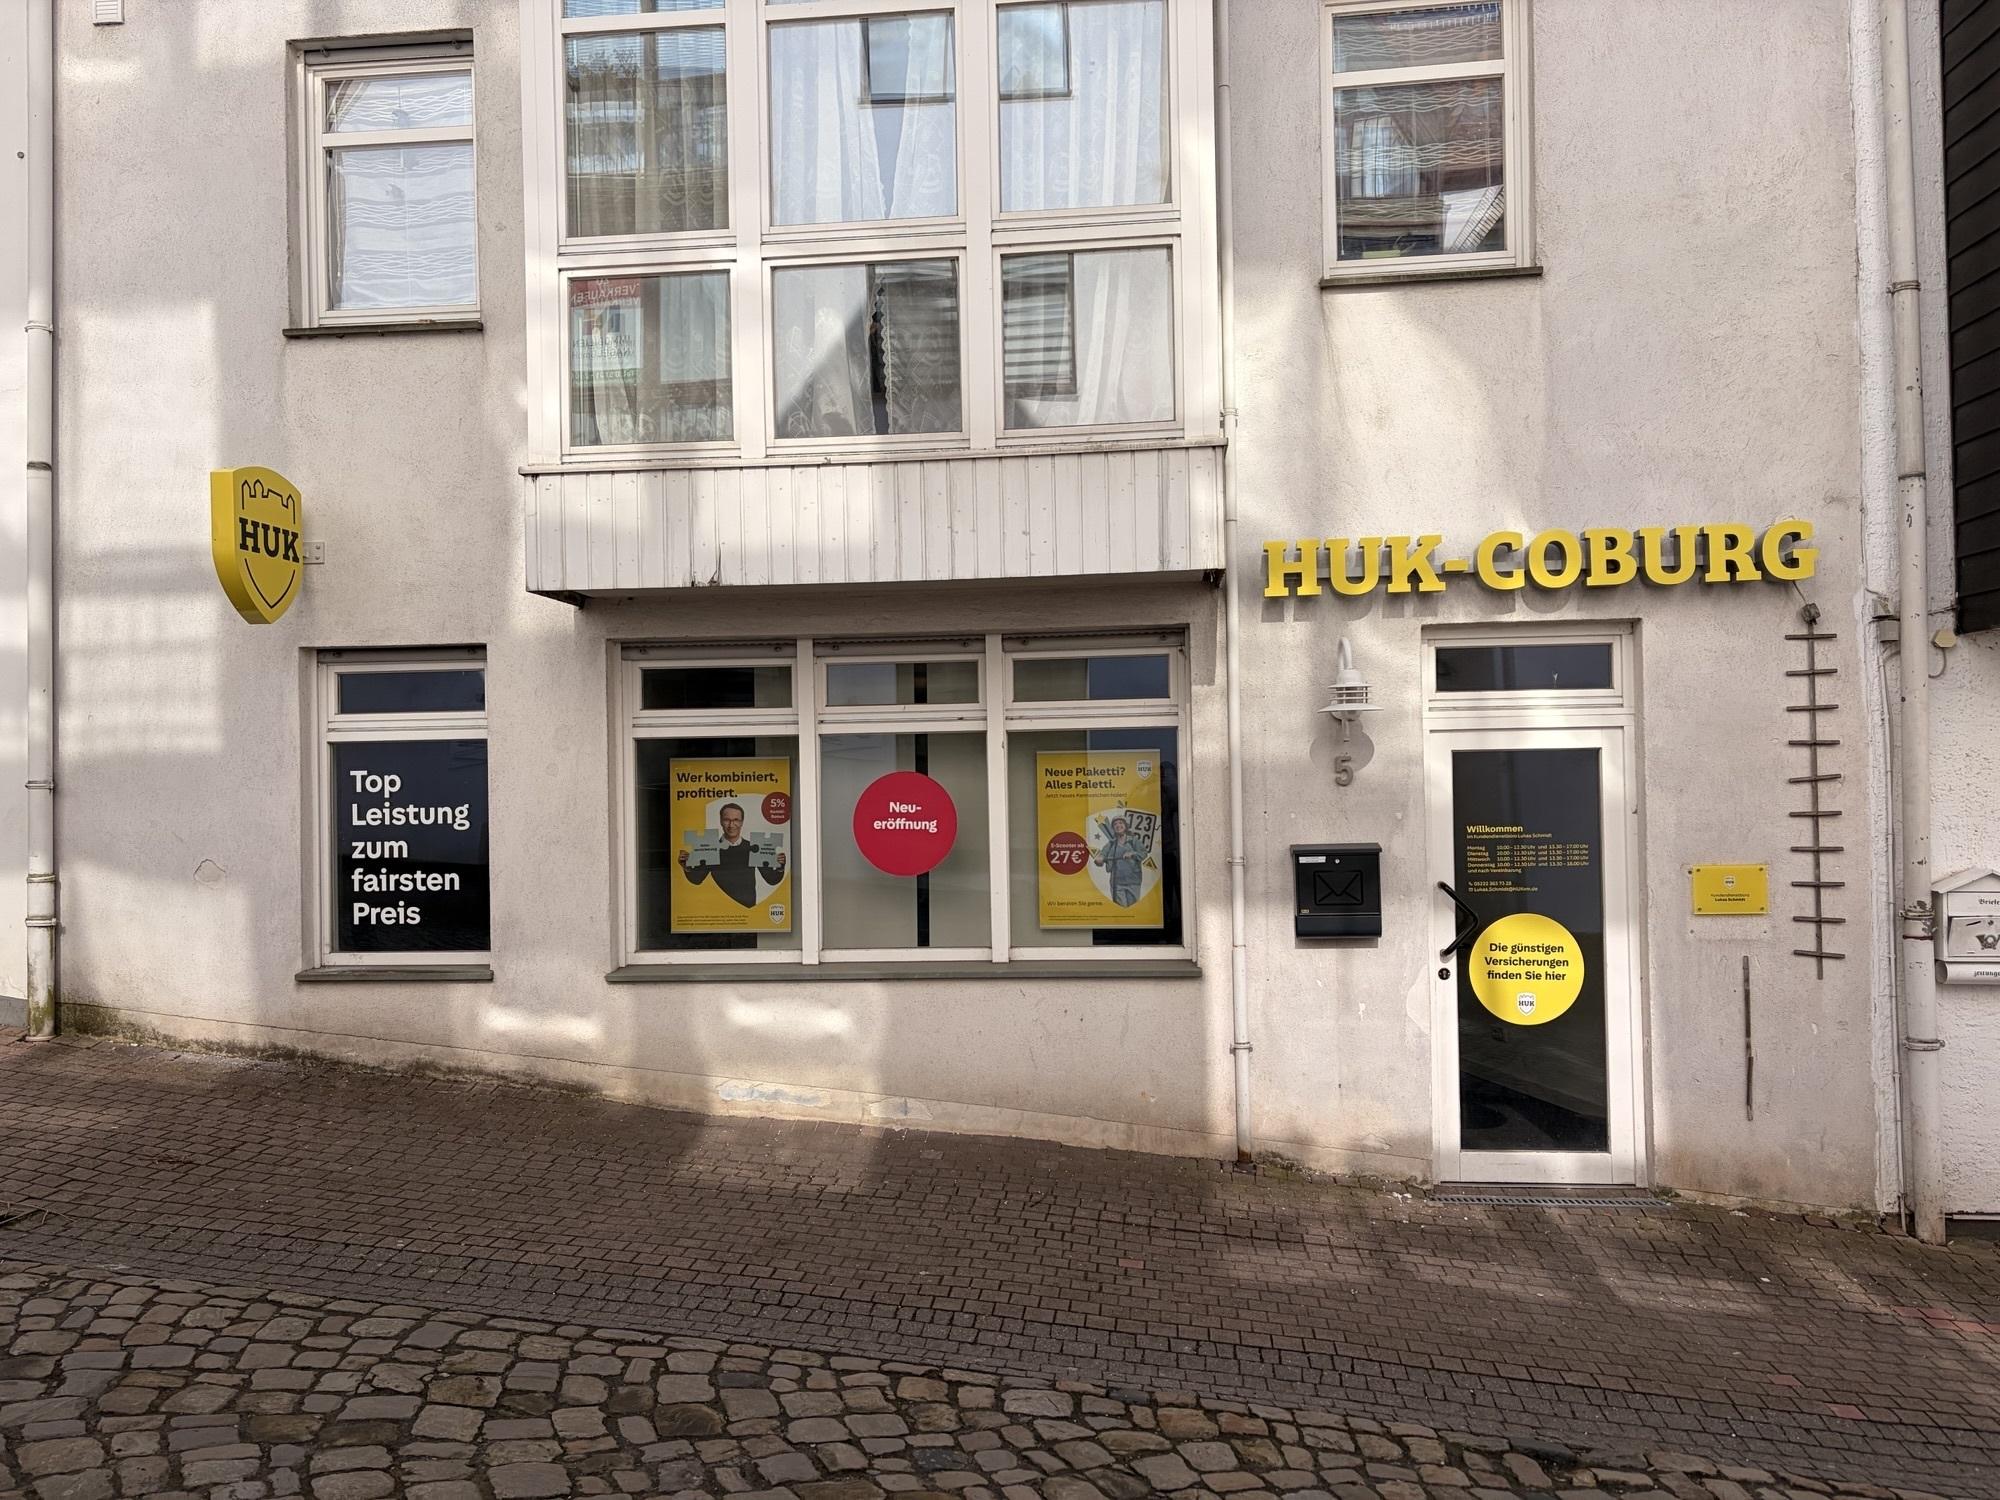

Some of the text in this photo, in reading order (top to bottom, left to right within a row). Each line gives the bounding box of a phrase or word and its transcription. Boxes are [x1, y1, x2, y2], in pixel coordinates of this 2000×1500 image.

[239, 517, 299, 562] HUK
[1263, 519, 1818, 597] HUK-COBURG
[677, 772, 778, 783] Wer kombiniert,
[1045, 767, 1126, 776] Neue Plaketti?
[1334, 756, 1353, 787] 5
[350, 770, 401, 797] Top
[1045, 779, 1116, 789] Alles Paletti.
[677, 788, 738, 801] profitiert.
[770, 798, 786, 808] 5%
[889, 801, 922, 813] Neu-
[351, 803, 470, 830] Leistung
[1127, 813, 1152, 832] 123
[873, 818, 938, 833] eröffnung
[1466, 825, 1523, 833] Willkommen
[351, 841, 408, 859] zum
[351, 869, 460, 891] fairsten
[352, 902, 421, 925] Preis
[1489, 943, 1564, 955] Die günstigen
[1485, 957, 1569, 969] Versicherungen
[1487, 970, 1566, 980] finden Sie hier
